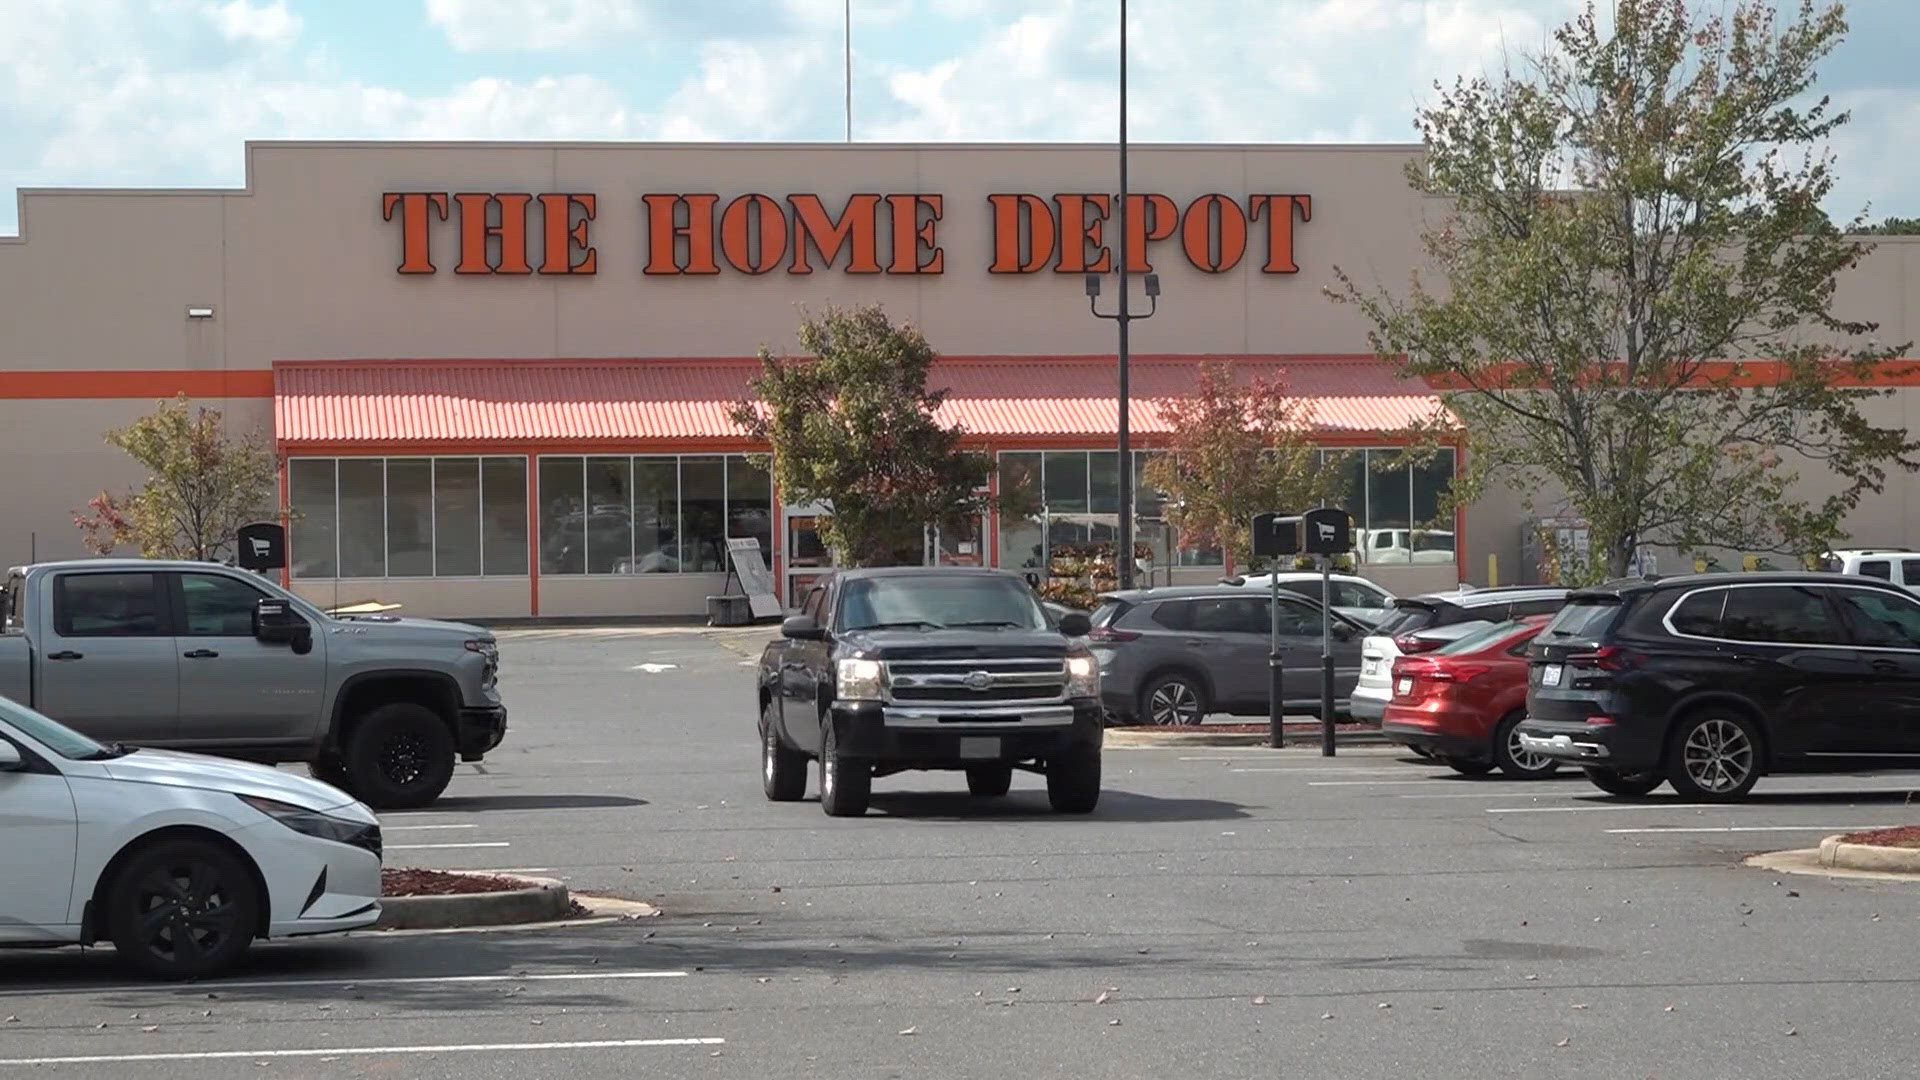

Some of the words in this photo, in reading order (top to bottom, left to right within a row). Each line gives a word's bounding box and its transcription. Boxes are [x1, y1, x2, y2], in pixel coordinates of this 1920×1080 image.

[383, 192, 597, 275] THE
[642, 193, 944, 275] HOME
[987, 193, 1312, 274] DEPOT
